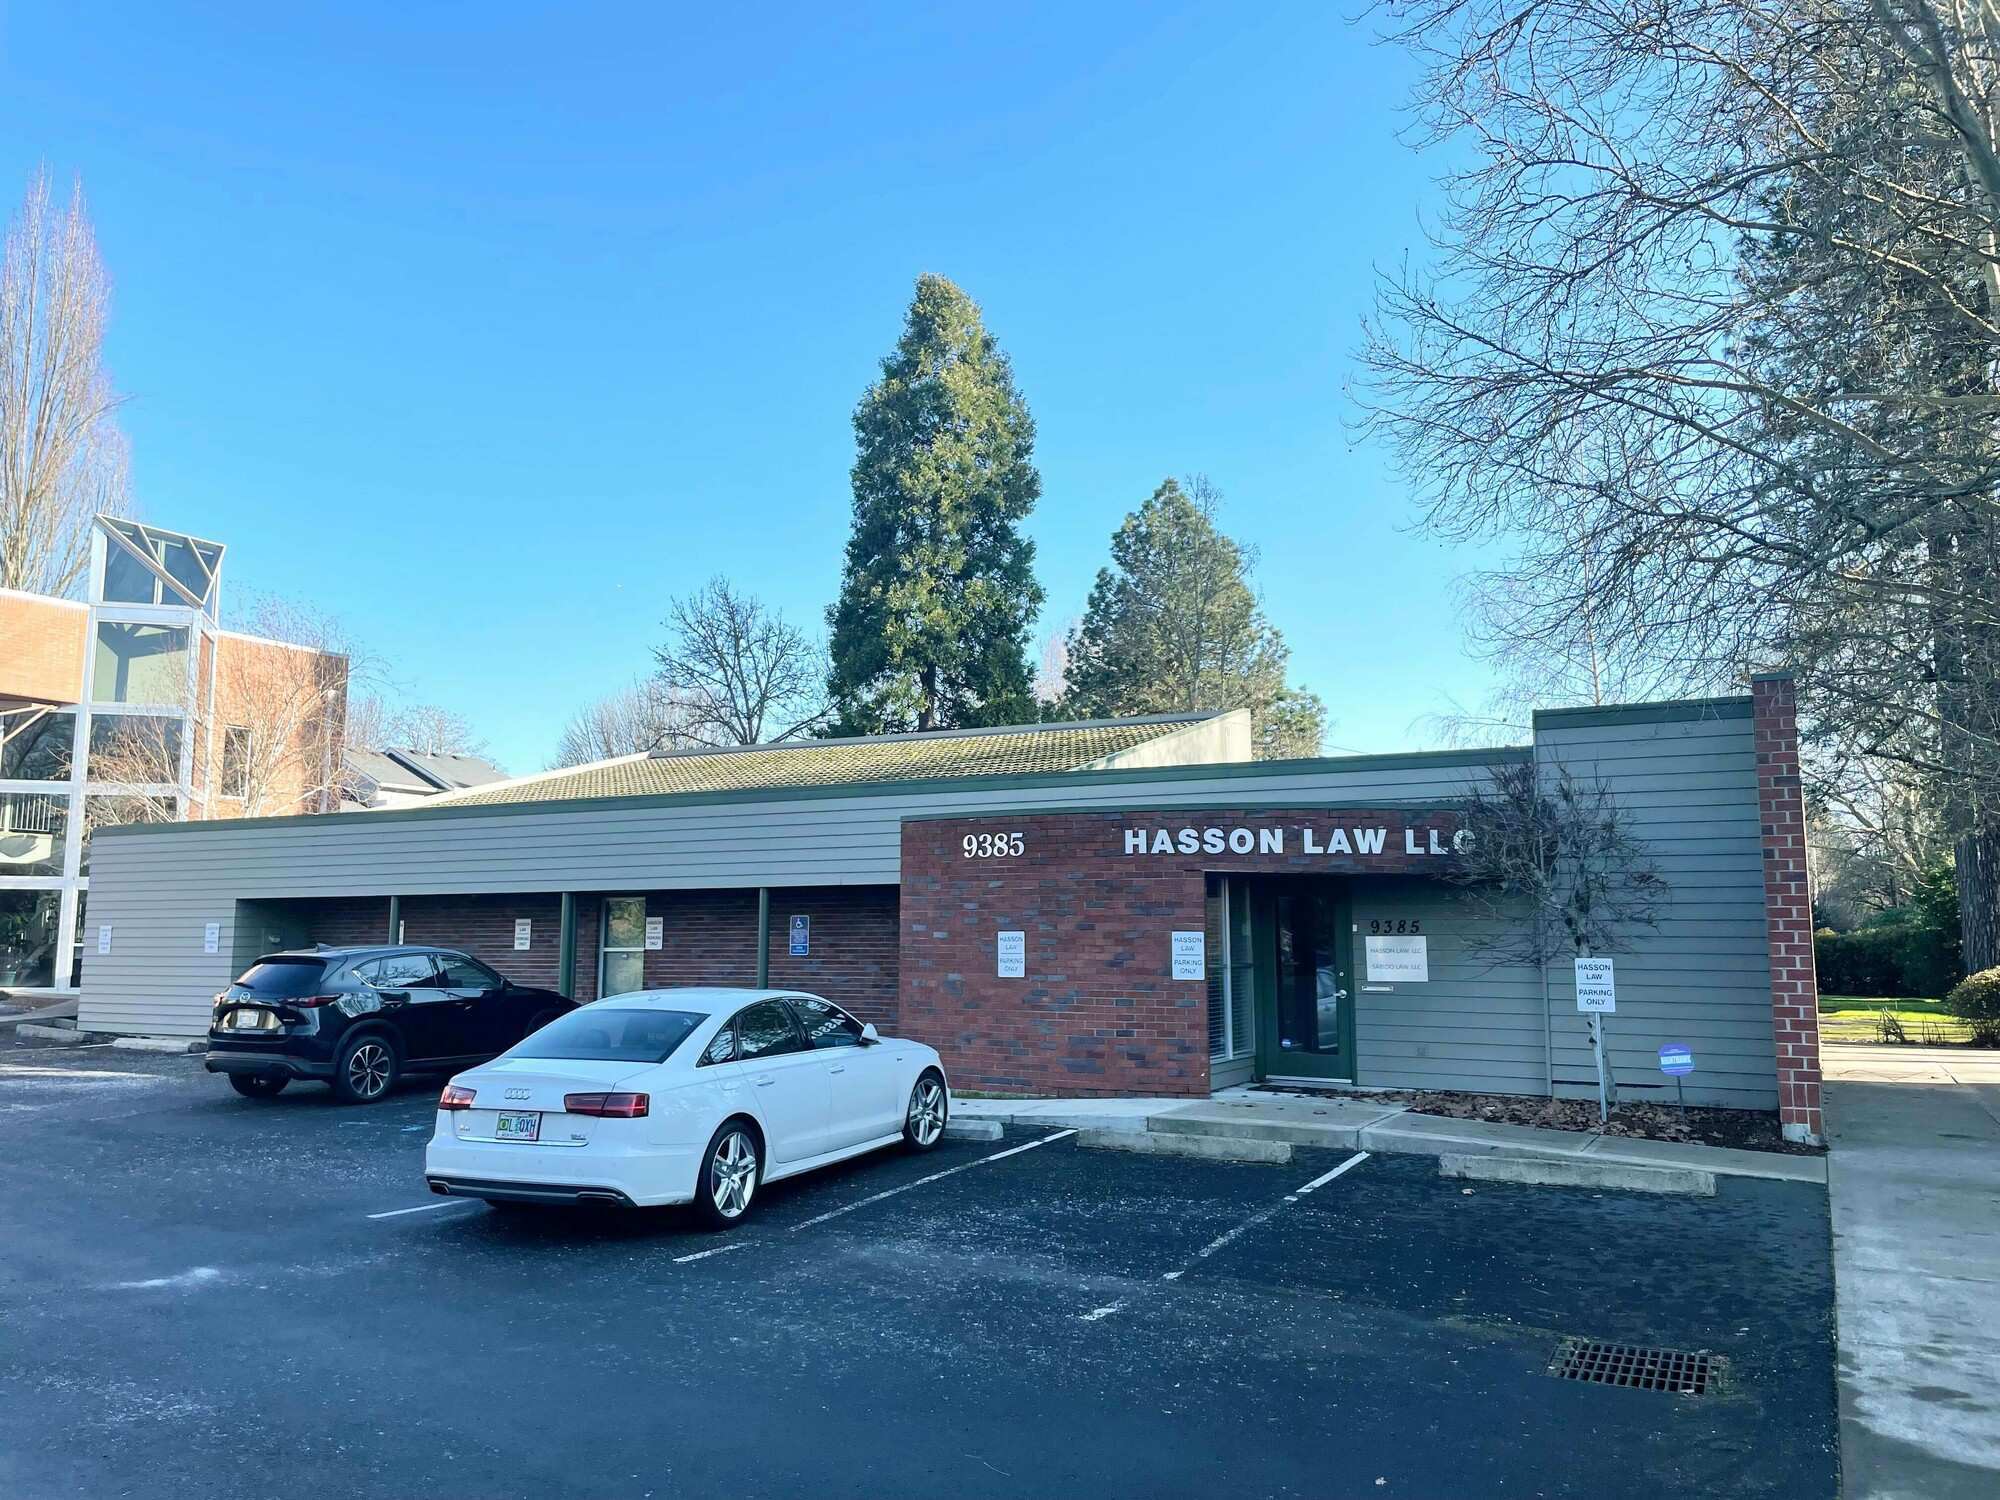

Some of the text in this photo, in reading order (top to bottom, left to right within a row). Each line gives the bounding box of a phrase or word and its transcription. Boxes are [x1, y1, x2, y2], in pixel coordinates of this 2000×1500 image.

[962, 832, 1025, 858] 9385
[1125, 828, 1284, 855] HASSON
[1303, 828, 1387, 855] LAW
[1370, 919, 1420, 934] 9385
[1578, 988, 1612, 996] PARKING
